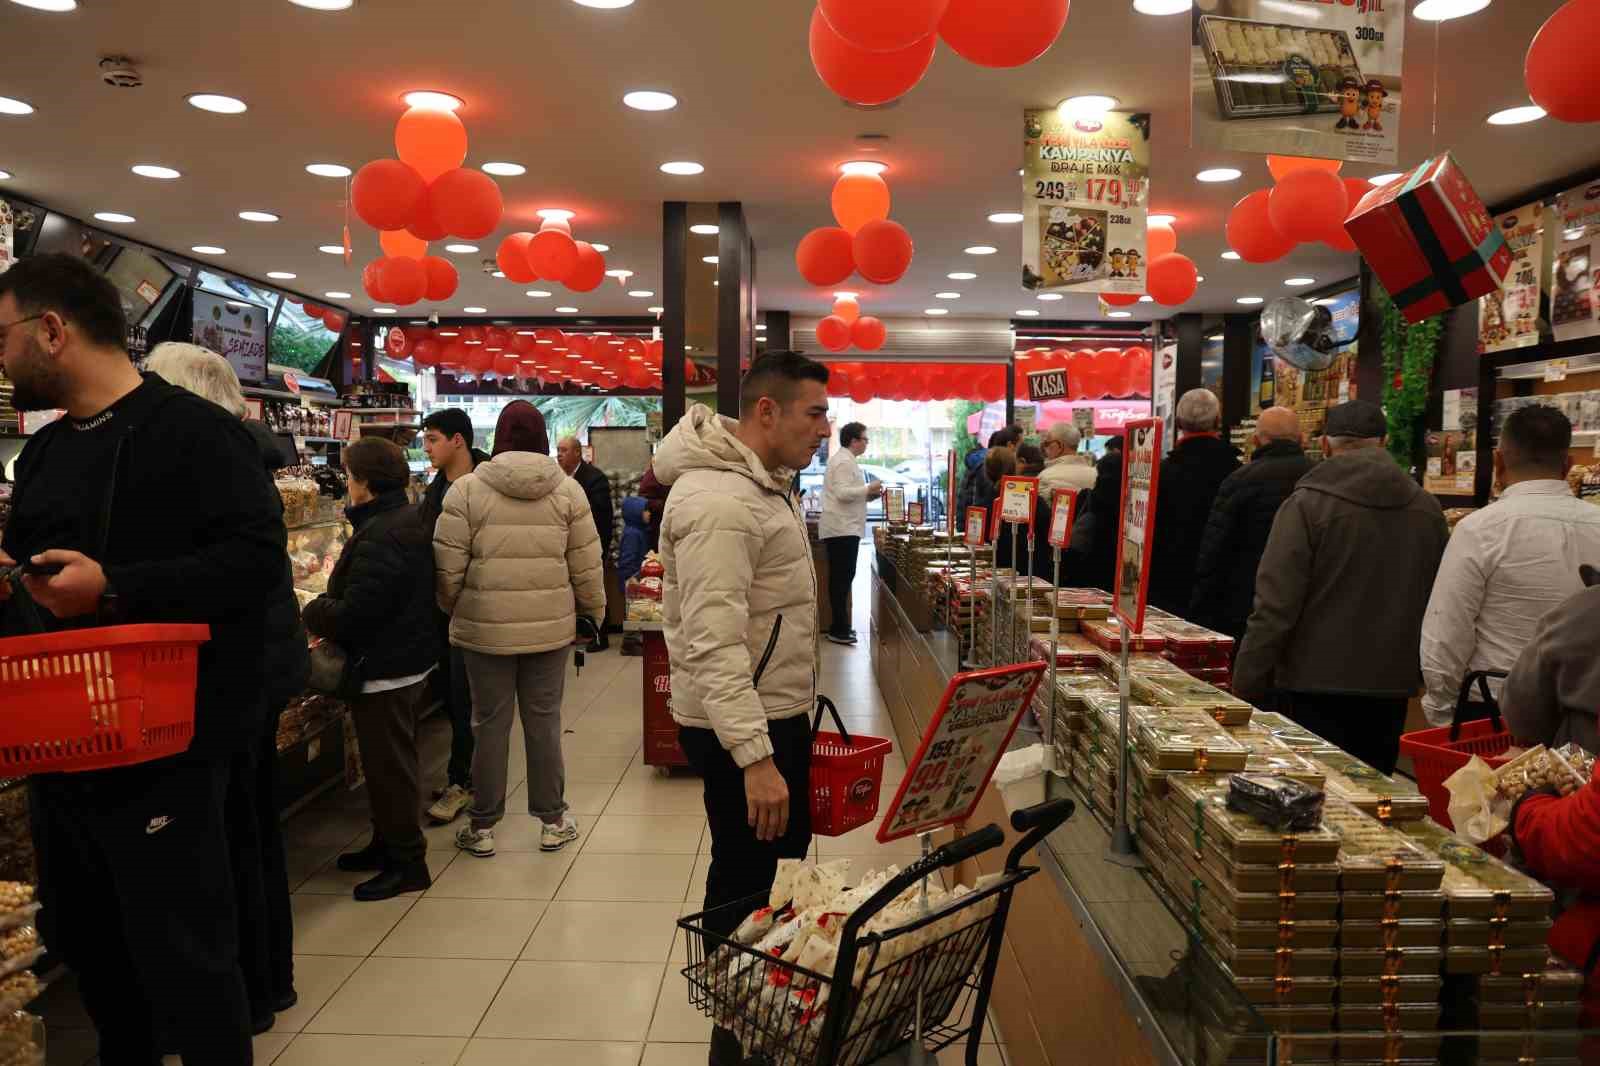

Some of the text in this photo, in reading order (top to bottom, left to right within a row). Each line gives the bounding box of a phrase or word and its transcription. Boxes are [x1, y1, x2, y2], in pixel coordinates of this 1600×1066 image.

[1039, 145, 1135, 164] KAMPANYA
[1050, 160, 1094, 175] DRAJE
[1031, 374, 1065, 398] KASA
[150, 816, 168, 827] NIKE
